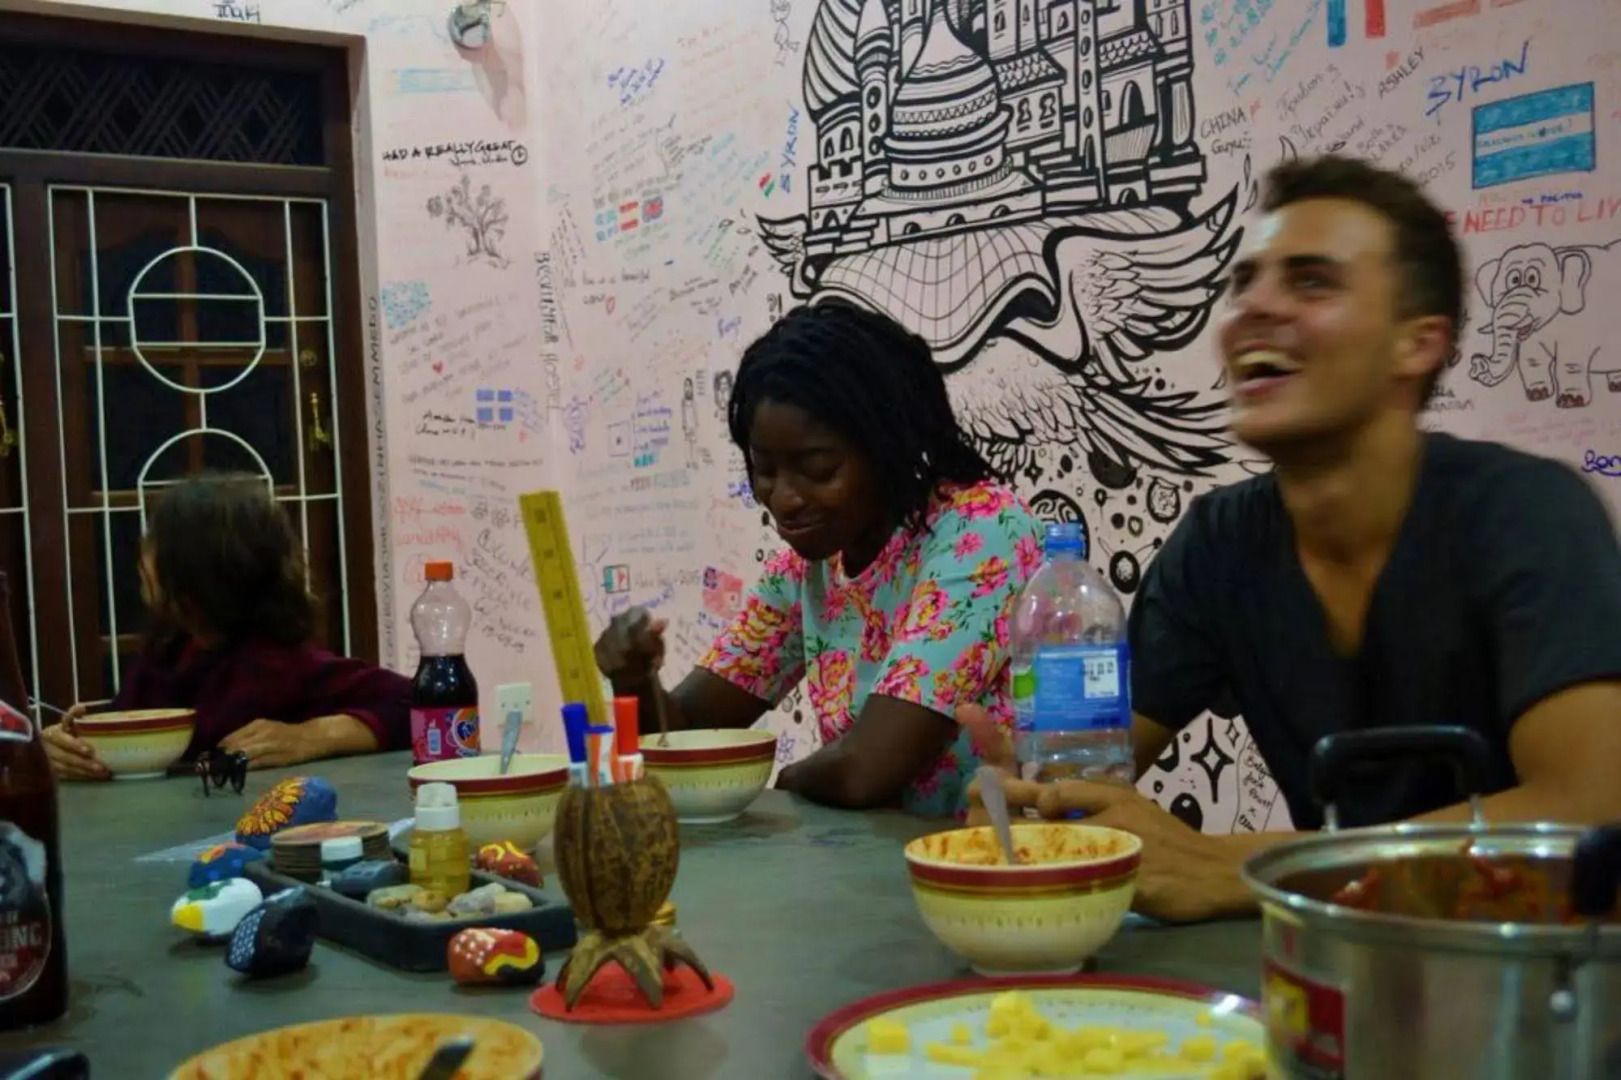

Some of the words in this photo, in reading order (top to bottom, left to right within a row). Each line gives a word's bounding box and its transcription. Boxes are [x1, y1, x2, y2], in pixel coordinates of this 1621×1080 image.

[1377, 46, 1425, 98] ASHLEY
[1425, 38, 1529, 117] BYRON
[1200, 107, 1246, 139] CHINA
[1463, 207, 1526, 236] NEED
[1530, 203, 1566, 227] TO
